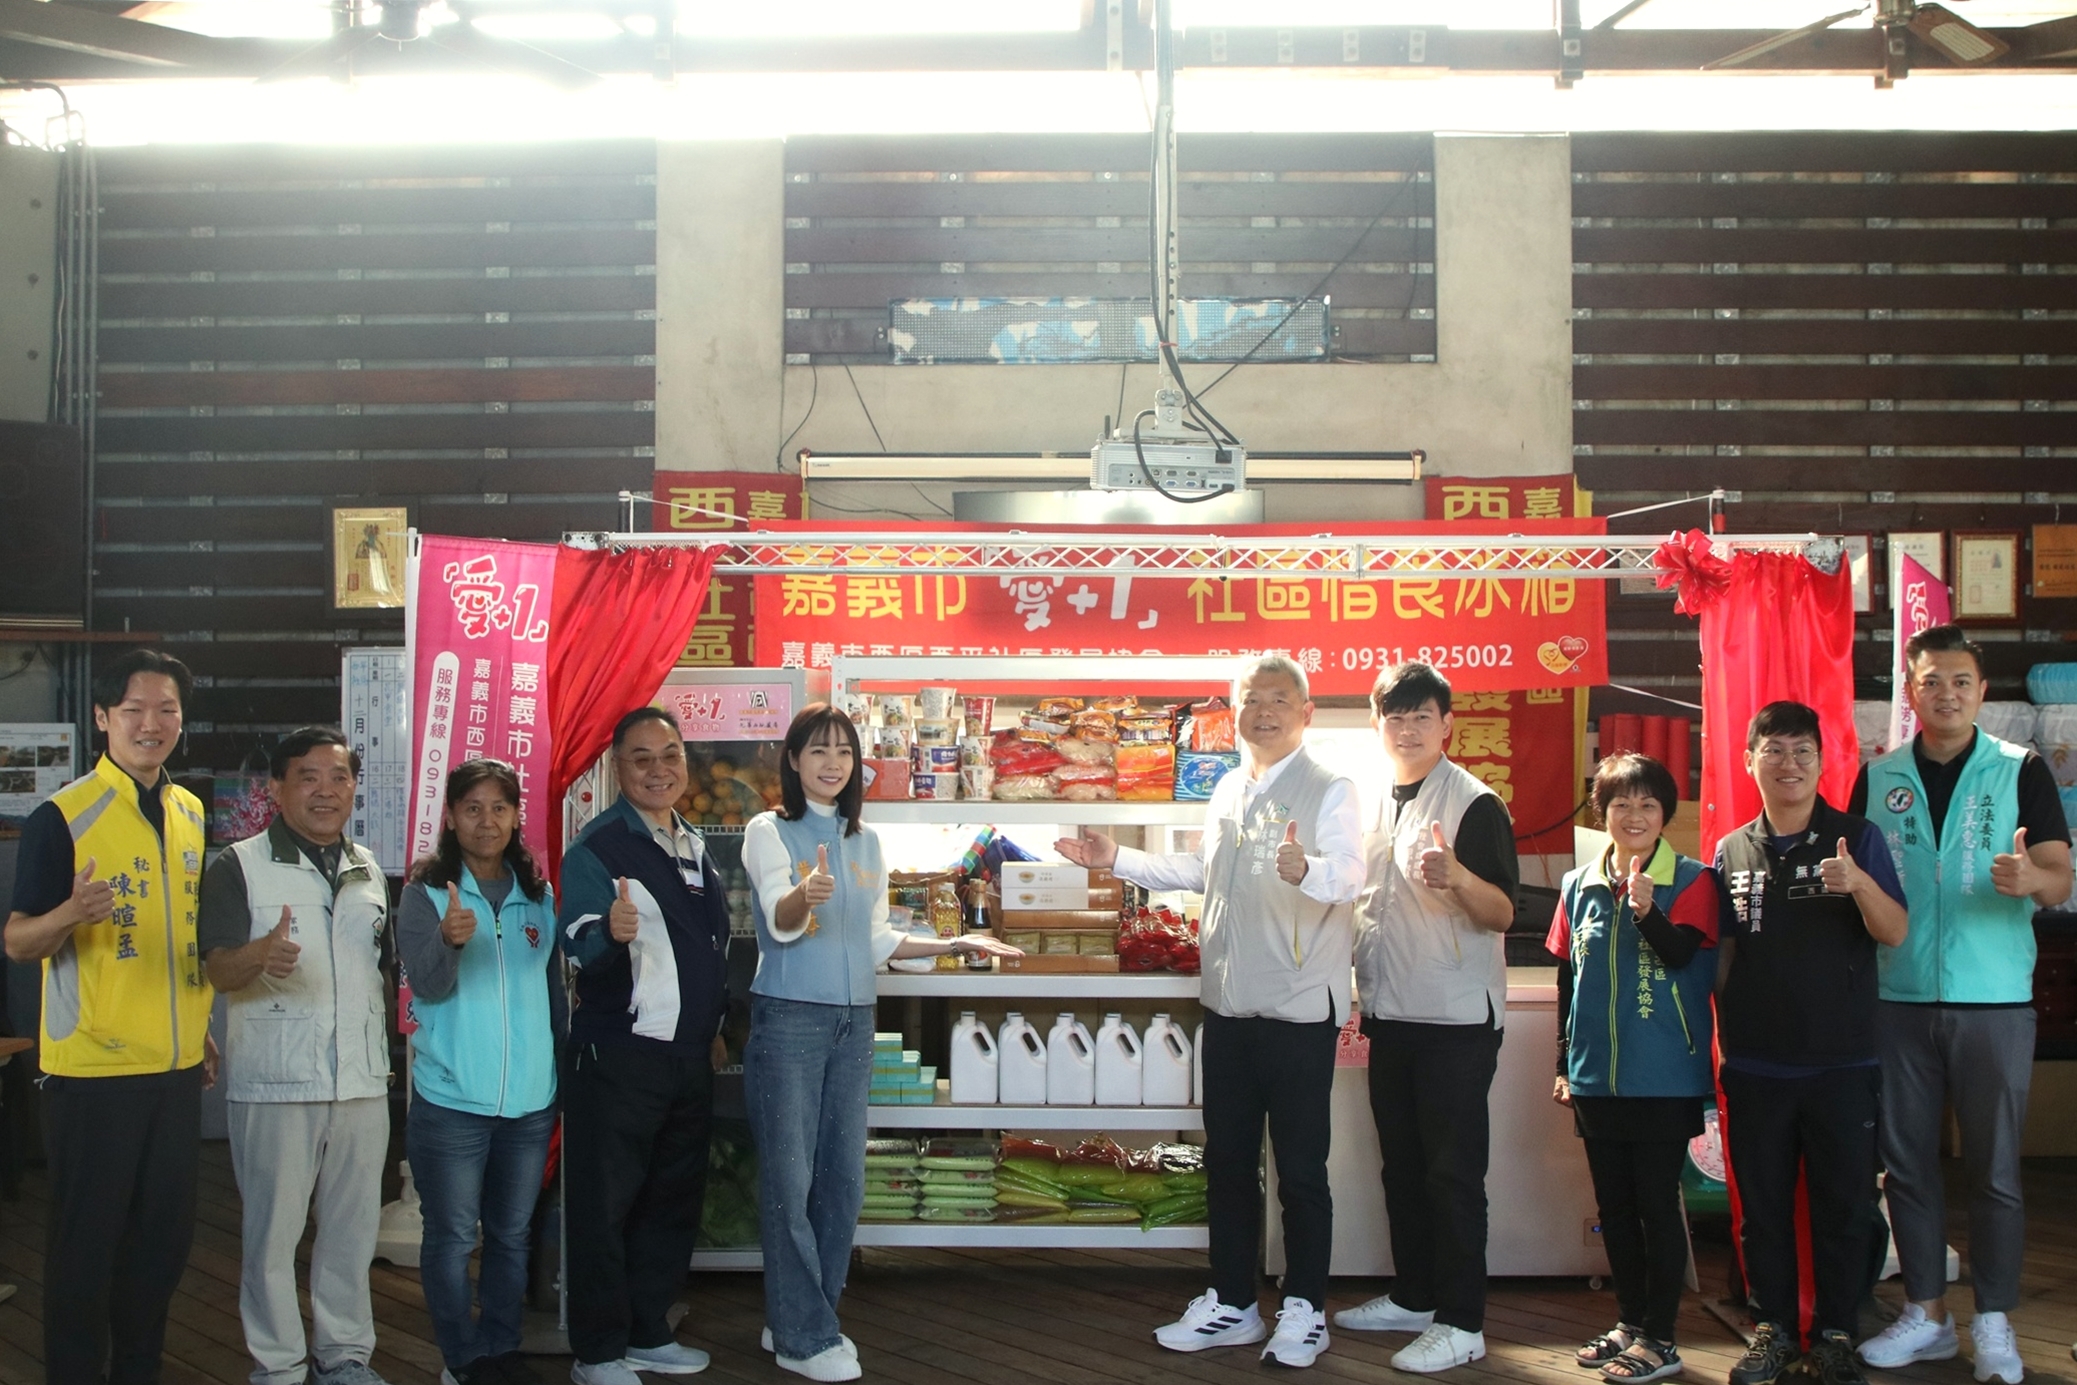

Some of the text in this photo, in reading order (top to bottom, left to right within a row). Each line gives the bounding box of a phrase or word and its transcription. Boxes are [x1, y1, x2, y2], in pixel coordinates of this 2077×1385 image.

[780, 545, 968, 621] 嘉義市
[1187, 547, 1576, 624] 社區惜食冰箱
[429, 668, 453, 739] 服務專線
[133, 856, 150, 898] 秘書
